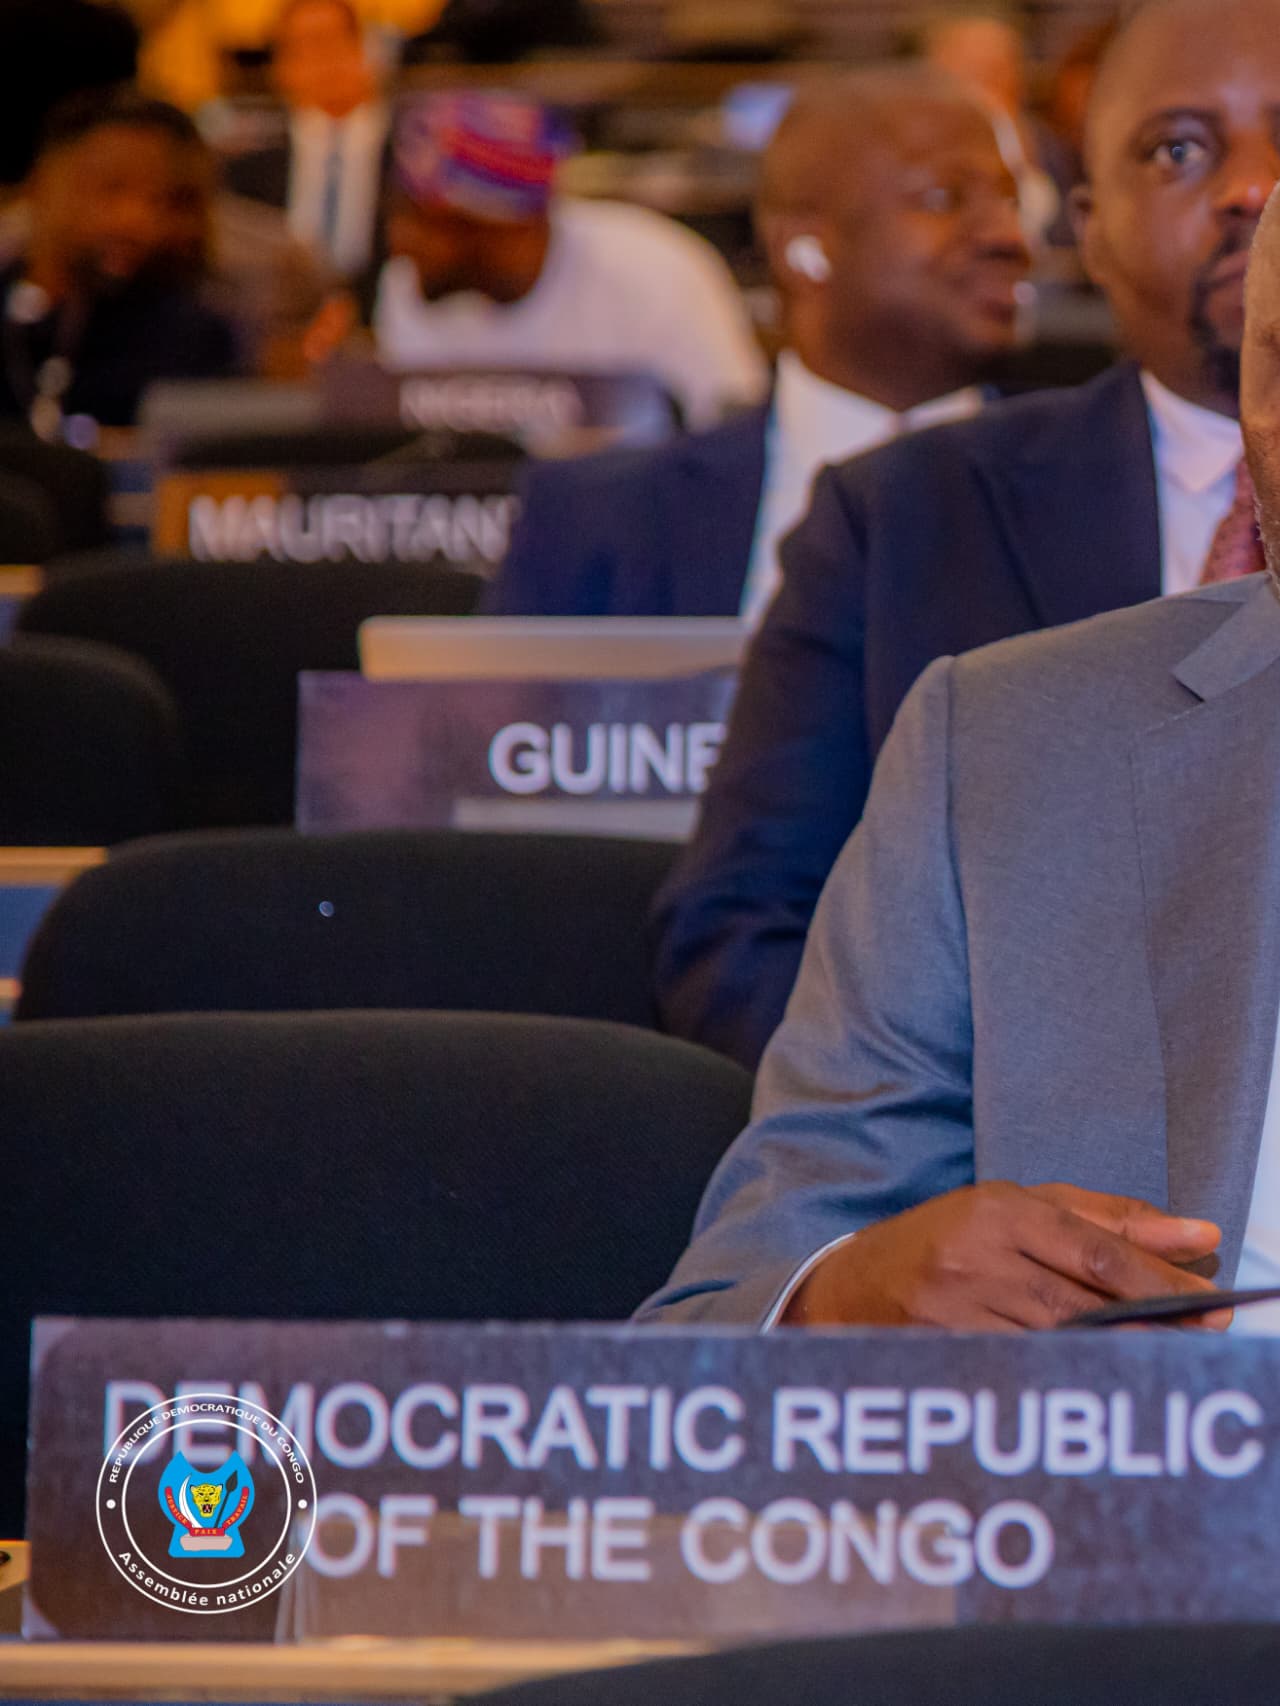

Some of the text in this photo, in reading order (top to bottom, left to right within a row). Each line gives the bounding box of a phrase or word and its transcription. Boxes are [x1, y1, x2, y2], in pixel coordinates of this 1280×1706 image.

[103, 1379, 1264, 1478] DEMOCRATIC REPUBLIC
[303, 1493, 1055, 1588] OF THE CONGO
